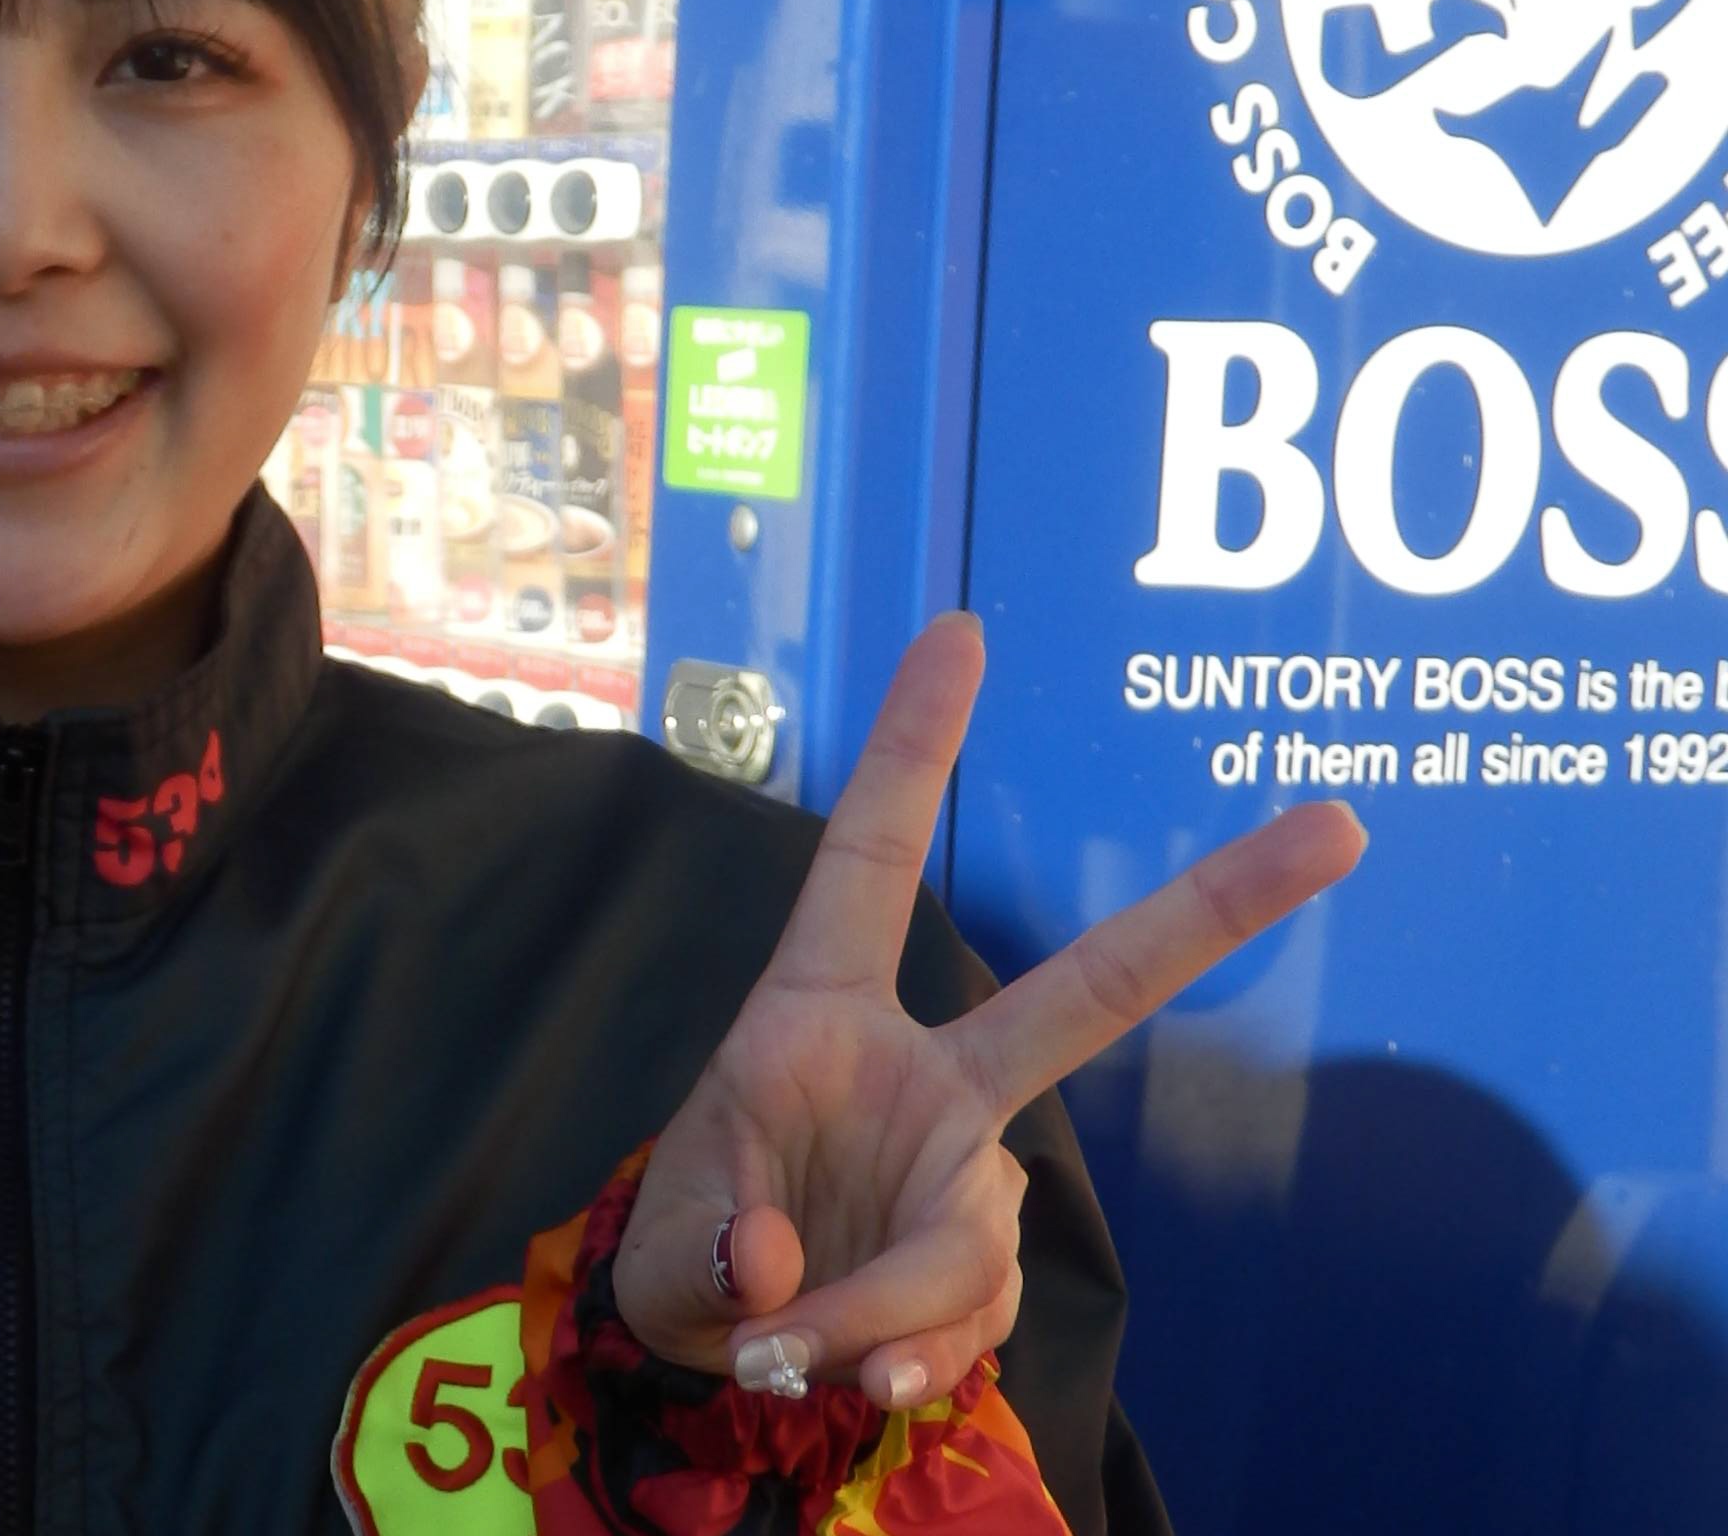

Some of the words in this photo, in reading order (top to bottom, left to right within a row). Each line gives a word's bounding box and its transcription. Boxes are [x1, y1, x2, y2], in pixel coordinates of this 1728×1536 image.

[1210, 83, 1377, 297] BOSS
[1134, 320, 1728, 598] BOS
[1124, 654, 1402, 711] SUNTORY
[1414, 657, 1564, 712] BOSS
[1577, 659, 1617, 712] is
[1629, 660, 1704, 712] the
[1211, 731, 1264, 785] of
[1275, 731, 1398, 786] them
[1412, 732, 1469, 785] all
[1481, 732, 1608, 786] since
[1624, 733, 1728, 785] 1992
